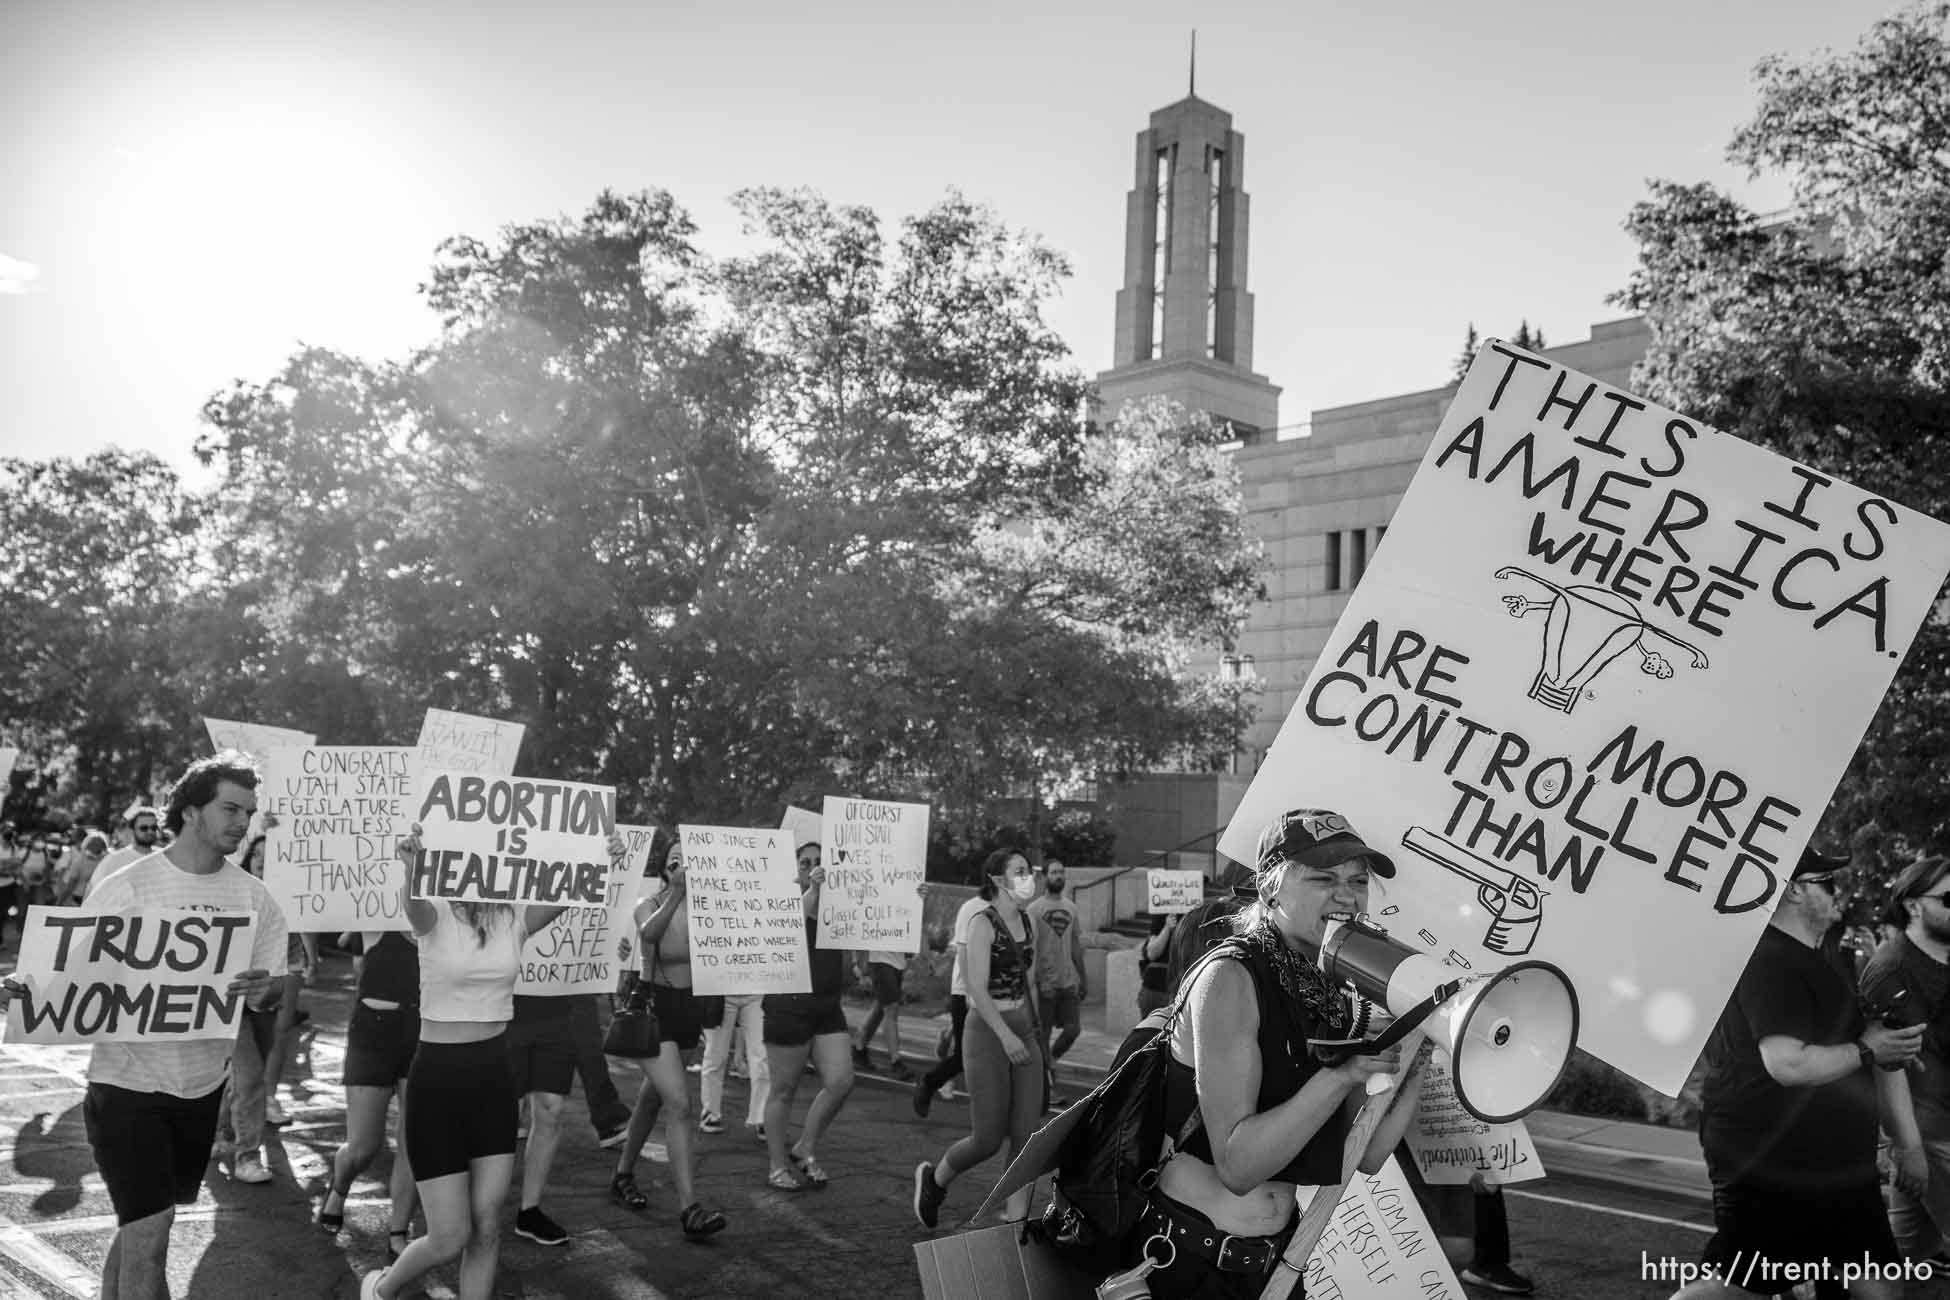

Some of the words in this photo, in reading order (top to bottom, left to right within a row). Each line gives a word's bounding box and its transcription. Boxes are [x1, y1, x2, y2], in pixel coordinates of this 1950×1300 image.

[1492, 345, 1698, 478] THIS
[1764, 466, 1898, 561] IS
[1435, 415, 1898, 658] AMERICA.
[1528, 511, 1745, 637] WHERE
[1337, 619, 1470, 709] ARE
[1588, 725, 1801, 865] MORE
[303, 750, 408, 776] CONGRATS
[287, 776, 338, 796] UTAH
[355, 775, 411, 795] STATE
[1305, 670, 1778, 913] CONTROLLED
[419, 775, 615, 836] ABORTION
[294, 817, 392, 837] COUNTLESS
[496, 827, 527, 855] IS
[688, 831, 714, 846] AND
[721, 834, 760, 849] SINCE
[1444, 780, 1606, 894] THAN
[277, 839, 336, 863] WILL
[687, 855, 717, 871] MAN
[298, 862, 389, 891] THANKS
[412, 848, 608, 903] HEALTHCARE
[690, 876, 729, 892] MAKE
[292, 894, 325, 917] TO
[692, 895, 709, 911] HE
[714, 899, 738, 913] HAS
[743, 898, 763, 911] NO
[767, 896, 801, 913] RIGHT
[691, 915, 714, 929] TO
[720, 917, 749, 929] TELL
[753, 917, 762, 929] A
[766, 917, 804, 929] WOMAN
[44, 915, 251, 975] TRUST
[536, 921, 609, 958] SAFE
[694, 935, 733, 948] WHEN
[736, 936, 760, 948] AND
[696, 954, 719, 967] TO
[724, 953, 768, 965] CREATE
[771, 952, 796, 963] ONE
[22, 981, 240, 1036] WOMEN
[1365, 1175, 1427, 1259] WOMAN
[1336, 1194, 1400, 1284] HERSELF
